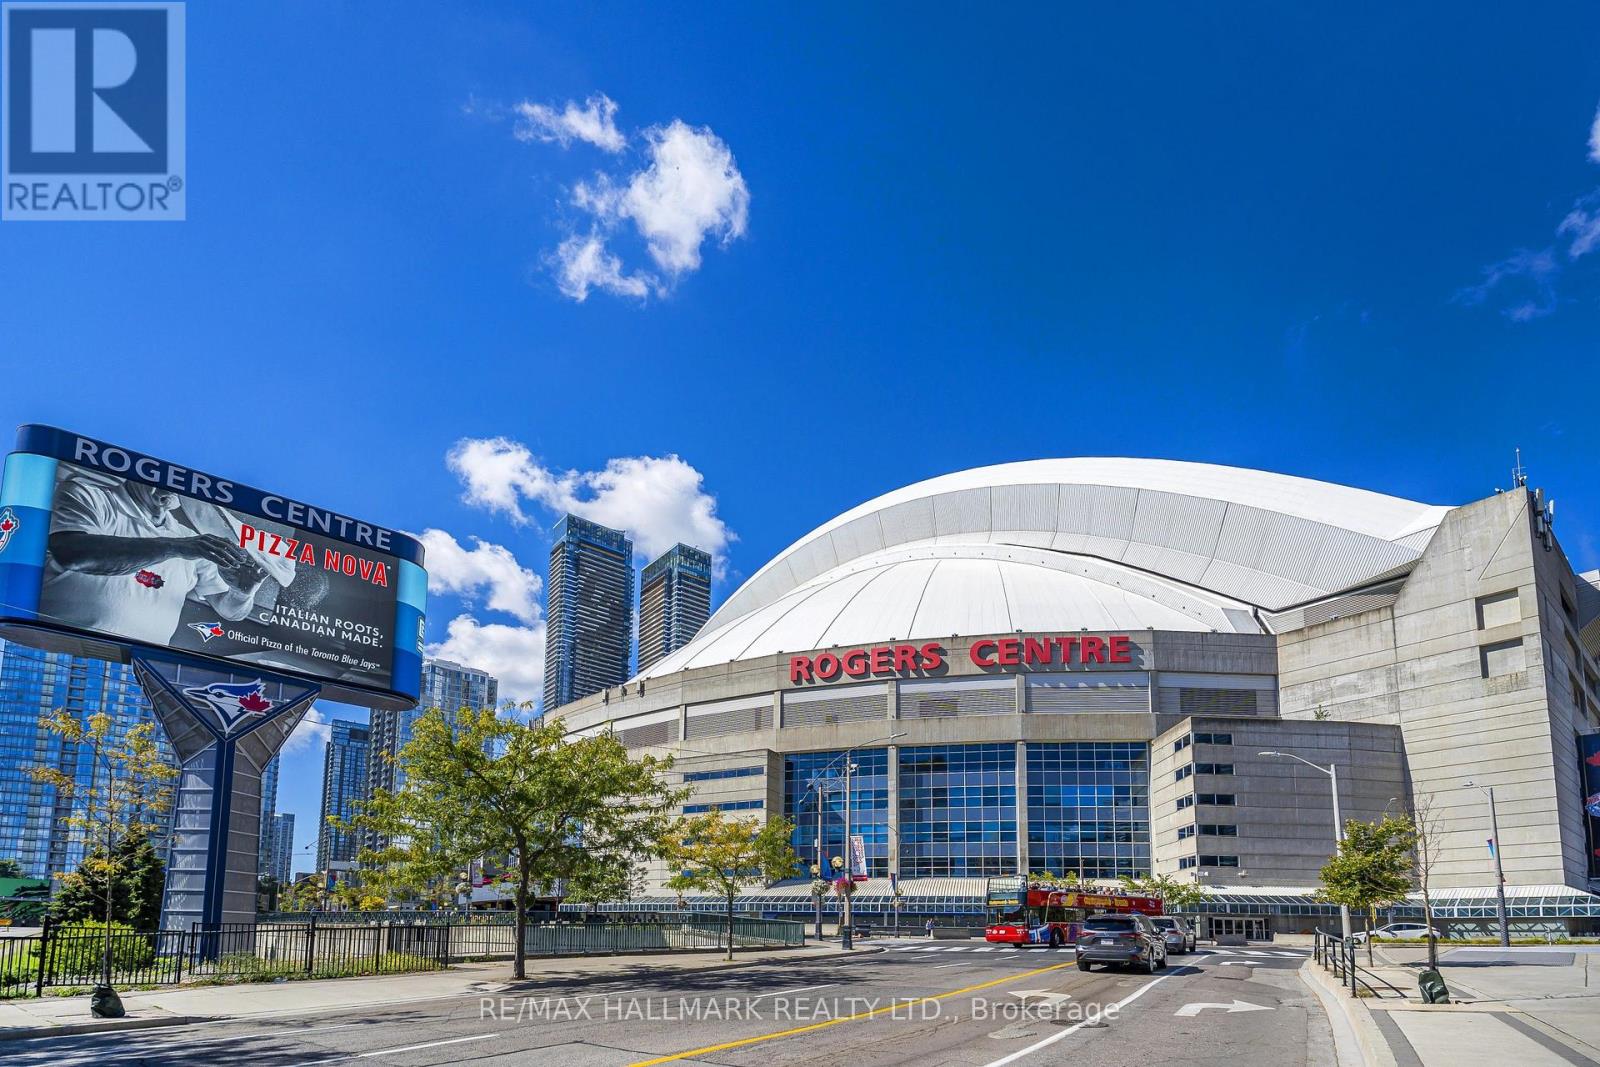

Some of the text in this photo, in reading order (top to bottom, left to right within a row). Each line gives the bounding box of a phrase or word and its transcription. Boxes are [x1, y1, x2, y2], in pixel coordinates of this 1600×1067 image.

[74, 437, 392, 551] ROGERS CENTRE
[239, 523, 315, 566] PIZZA
[259, 612, 383, 648] CANADIAN MADE.
[276, 604, 384, 639] ITALIAN ROOTS,
[227, 630, 259, 645] Official
[261, 637, 282, 650] Pizza
[284, 642, 293, 652] of
[295, 644, 309, 655] the
[311, 647, 340, 662] Toronto
[341, 654, 359, 666] Blue
[790, 636, 1133, 682] ROGERS CENTRE
